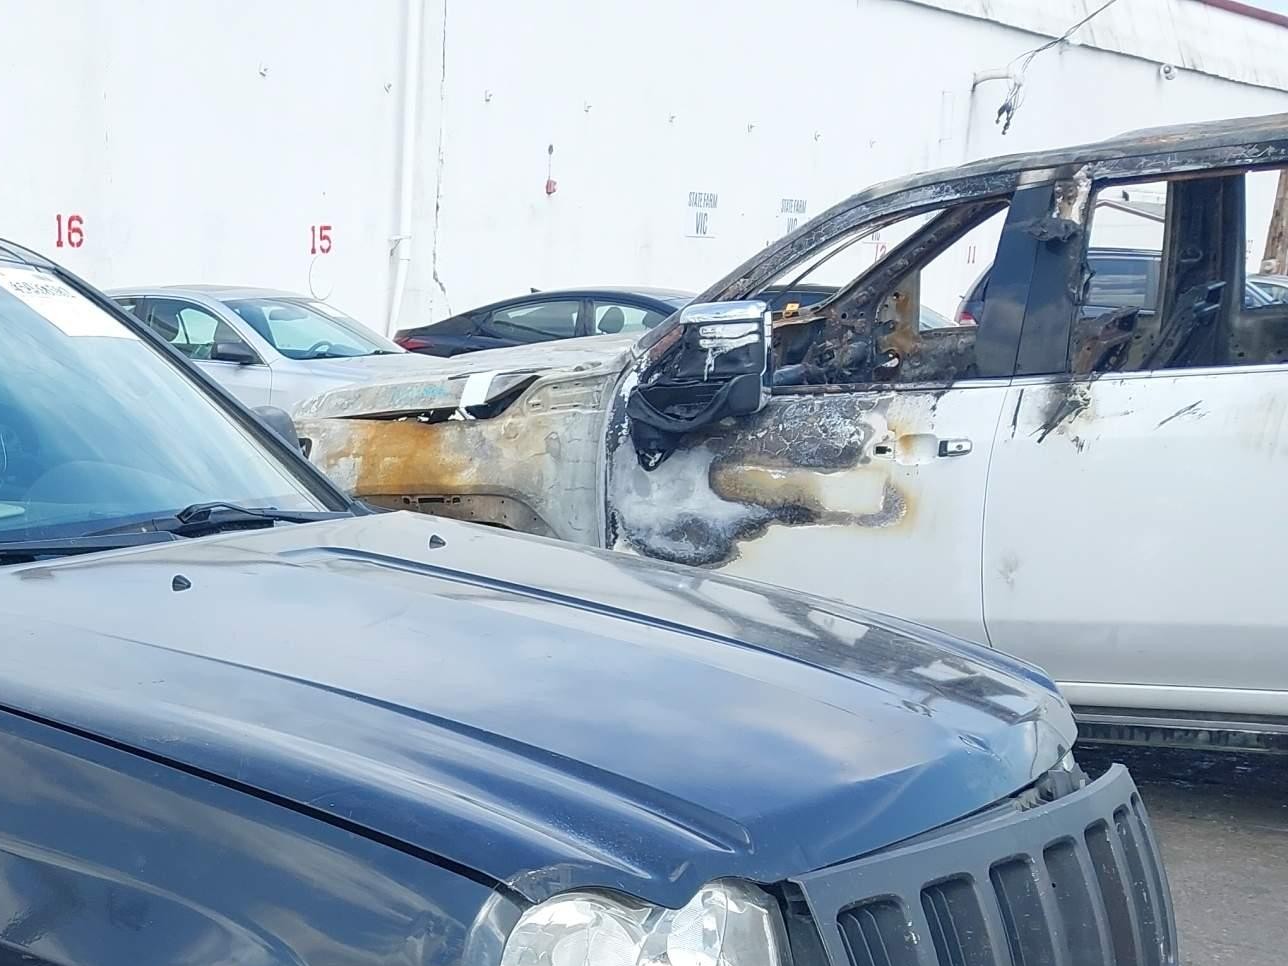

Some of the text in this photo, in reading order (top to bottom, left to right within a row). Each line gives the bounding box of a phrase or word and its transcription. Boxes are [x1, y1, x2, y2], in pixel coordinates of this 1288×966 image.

[688, 191, 718, 208] STATE FARM
[781, 198, 807, 214] STATE FARM
[56, 214, 84, 248] 16
[695, 211, 708, 235] VIC
[310, 225, 332, 254] 15
[967, 245, 976, 264] 11
